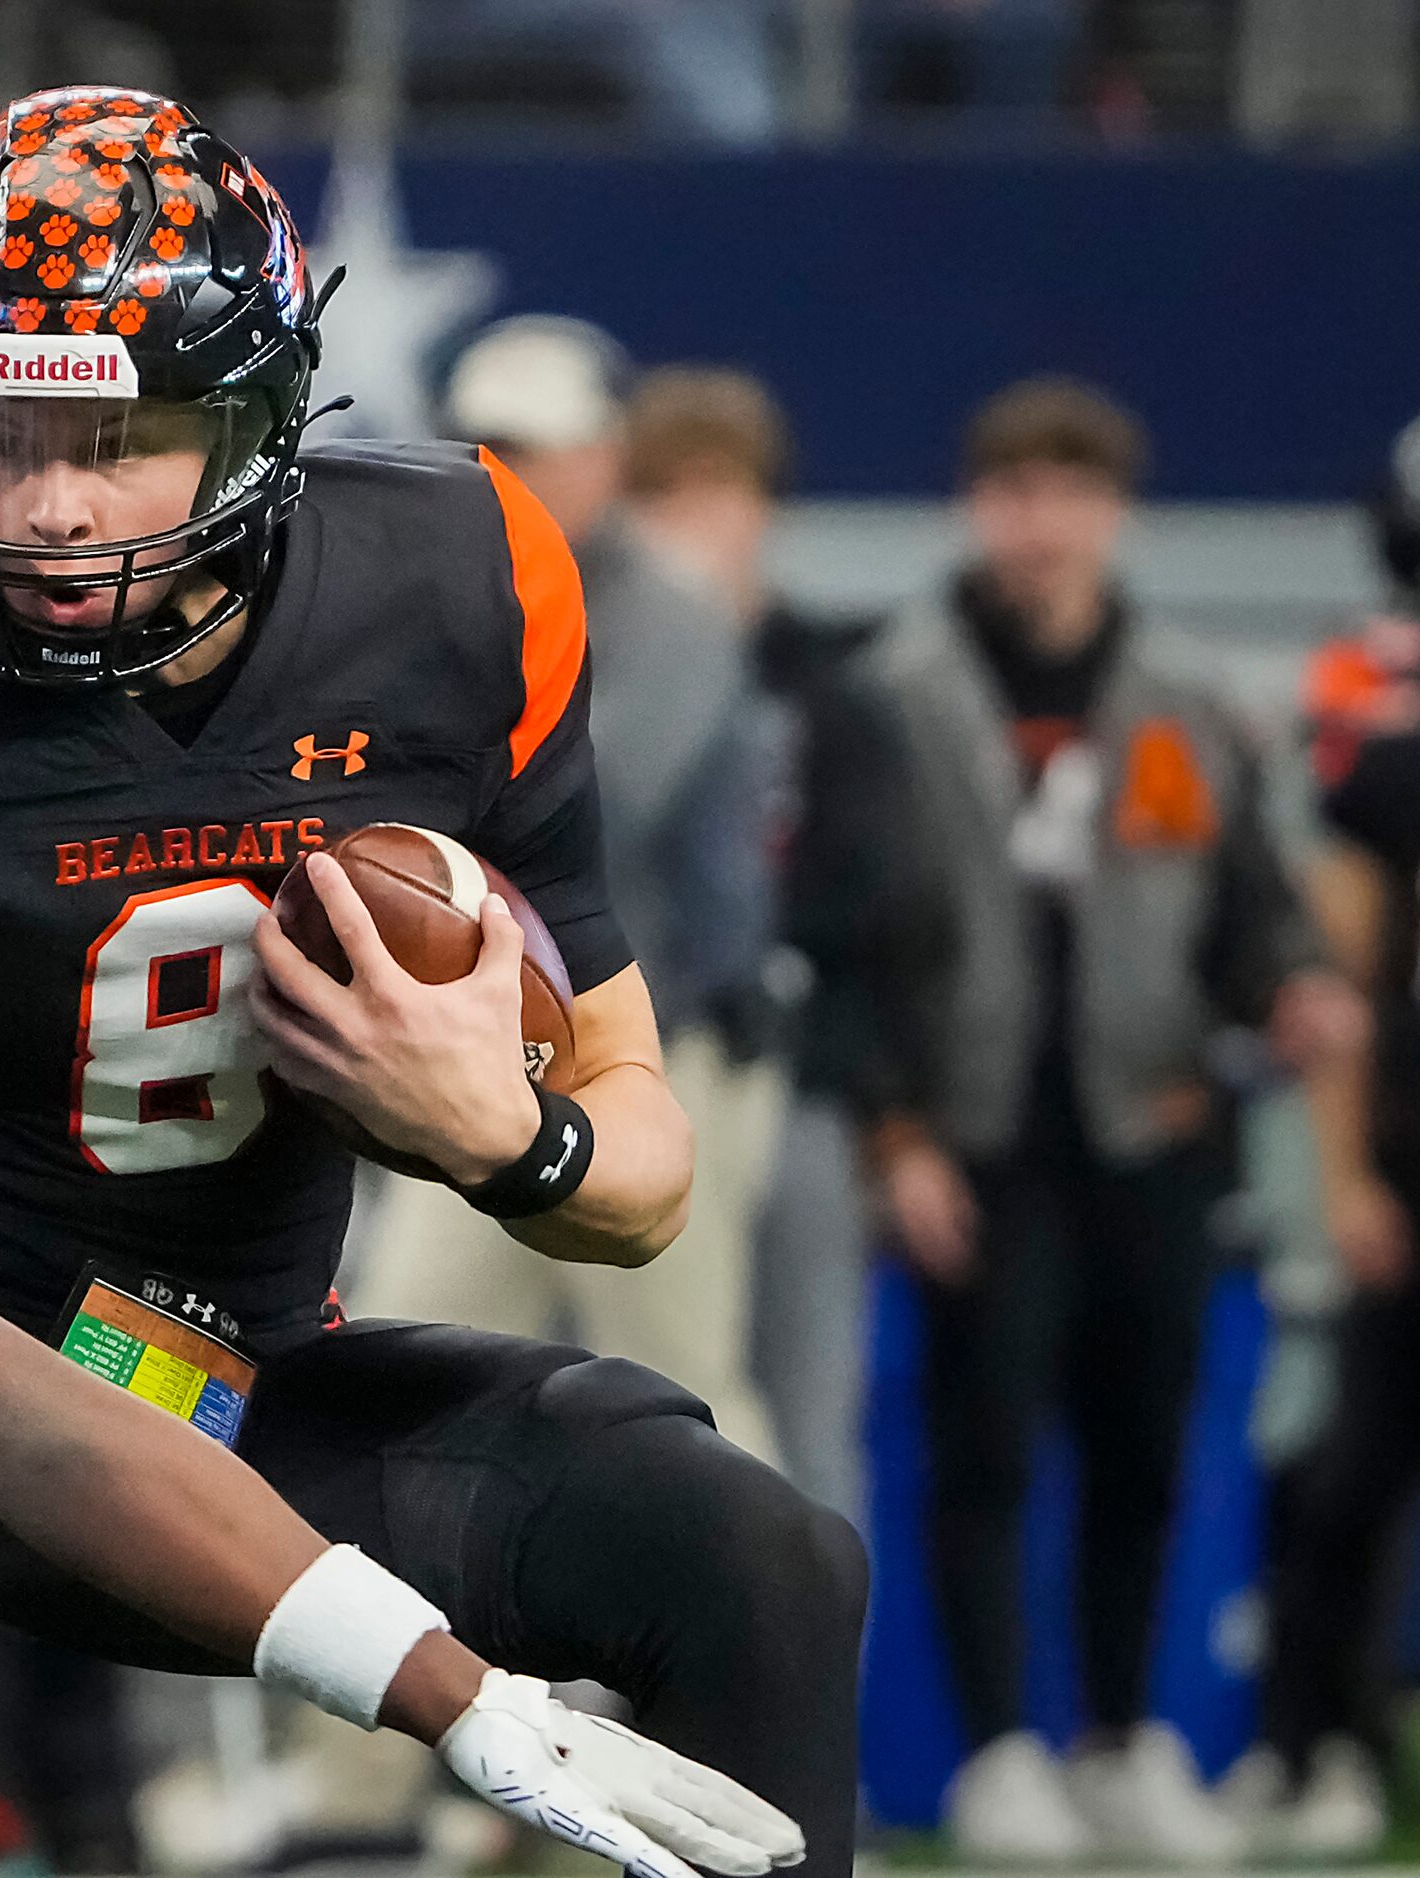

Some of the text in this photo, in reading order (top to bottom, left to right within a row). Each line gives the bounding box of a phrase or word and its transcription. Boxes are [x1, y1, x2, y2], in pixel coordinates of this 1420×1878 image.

[42, 647, 100, 665] Riddell
[55, 817, 324, 886] BEARCATS
[68, 877, 275, 1175] 8
